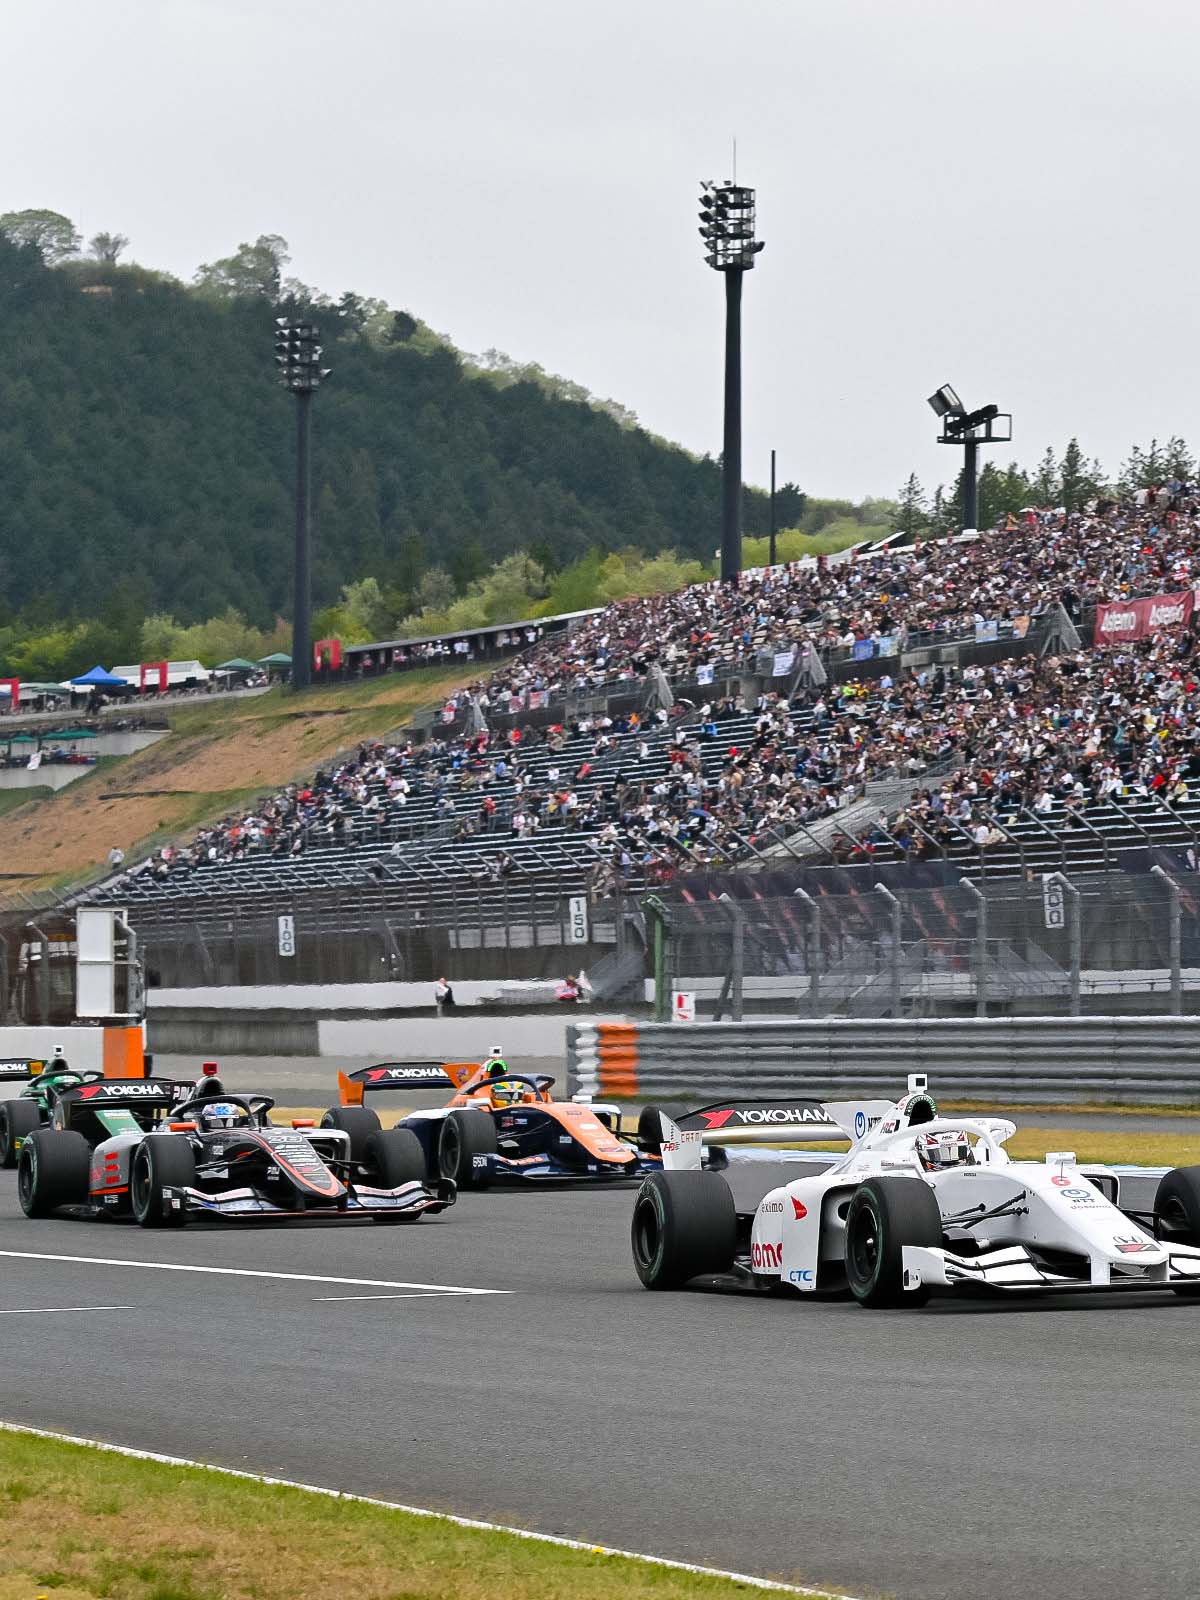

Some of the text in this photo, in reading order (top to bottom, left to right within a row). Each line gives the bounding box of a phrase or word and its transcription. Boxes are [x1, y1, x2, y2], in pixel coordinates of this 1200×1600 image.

[574, 900, 585, 938] 150
[282, 918, 292, 952] 100
[387, 1068, 448, 1078] YOKOHAM
[102, 1086, 164, 1096] YOKOHA
[736, 1109, 833, 1123] YOKOHAM
[790, 1270, 812, 1281] CTC
